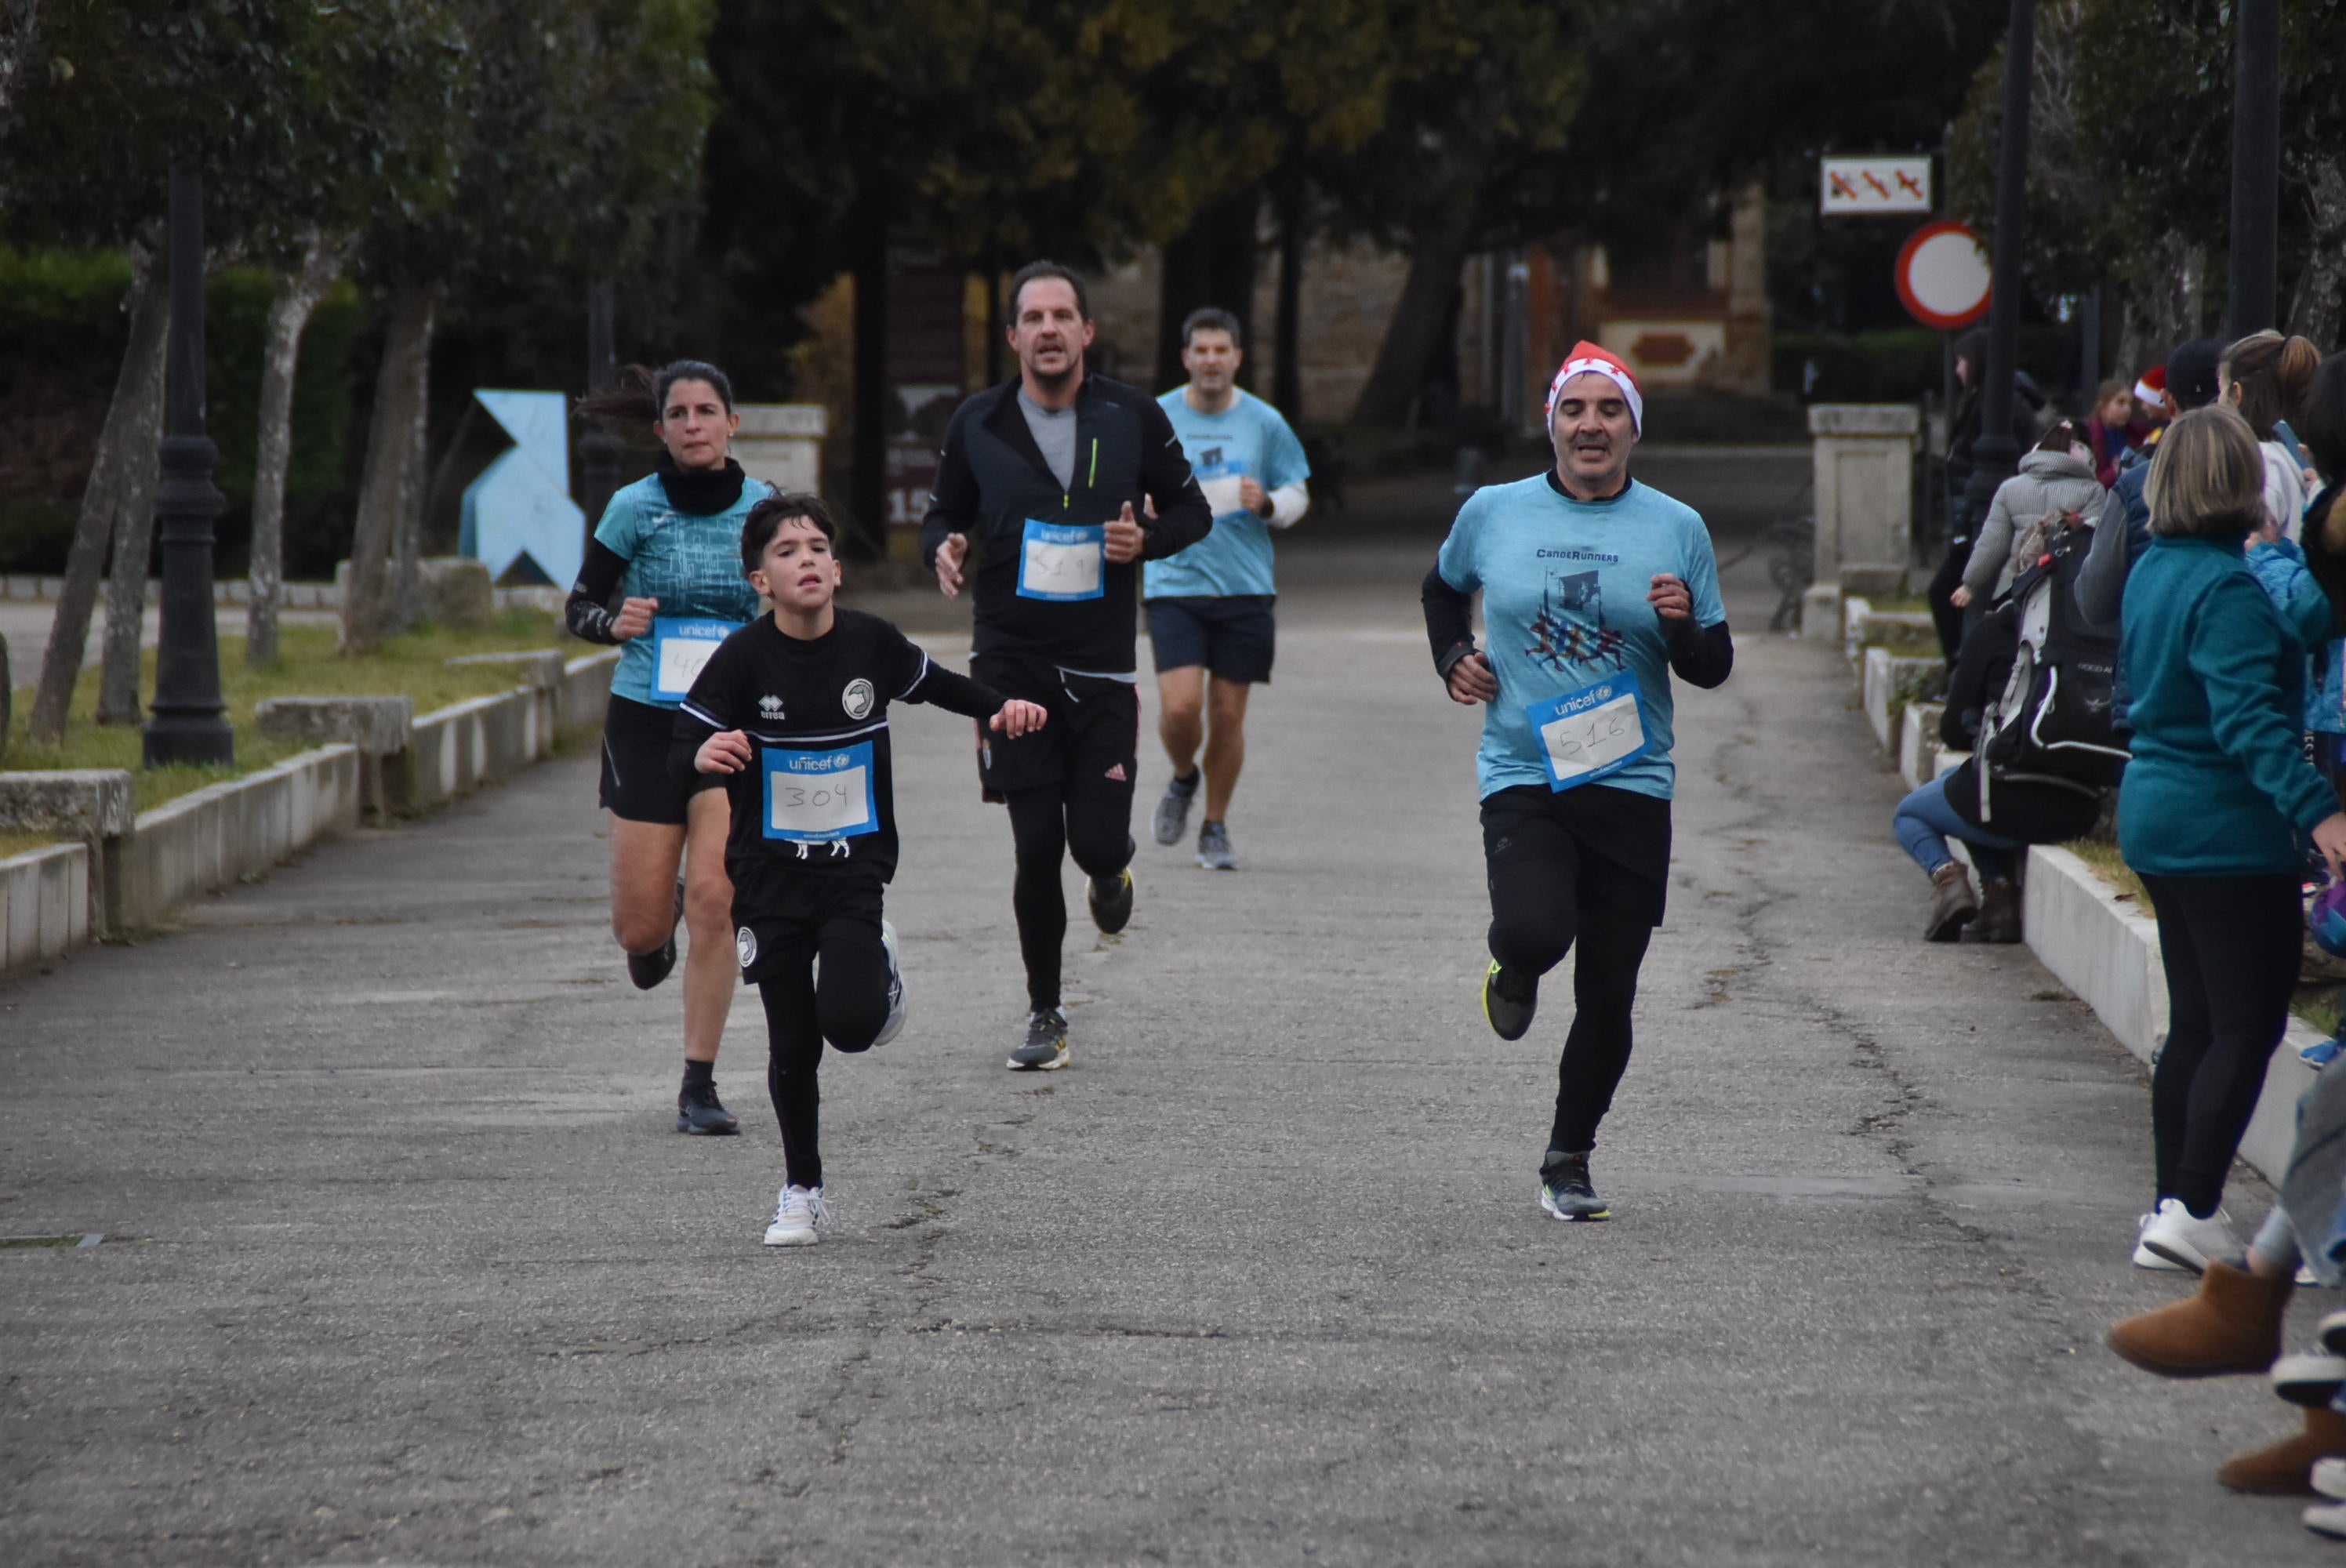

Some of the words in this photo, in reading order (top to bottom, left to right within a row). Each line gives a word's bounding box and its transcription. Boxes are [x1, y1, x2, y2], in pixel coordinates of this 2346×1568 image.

[679, 624, 716, 638] unicef
[1555, 689, 1596, 716] unicef
[1560, 716, 1625, 755] 516
[789, 755, 833, 771] unicef
[785, 783, 848, 810] 304
